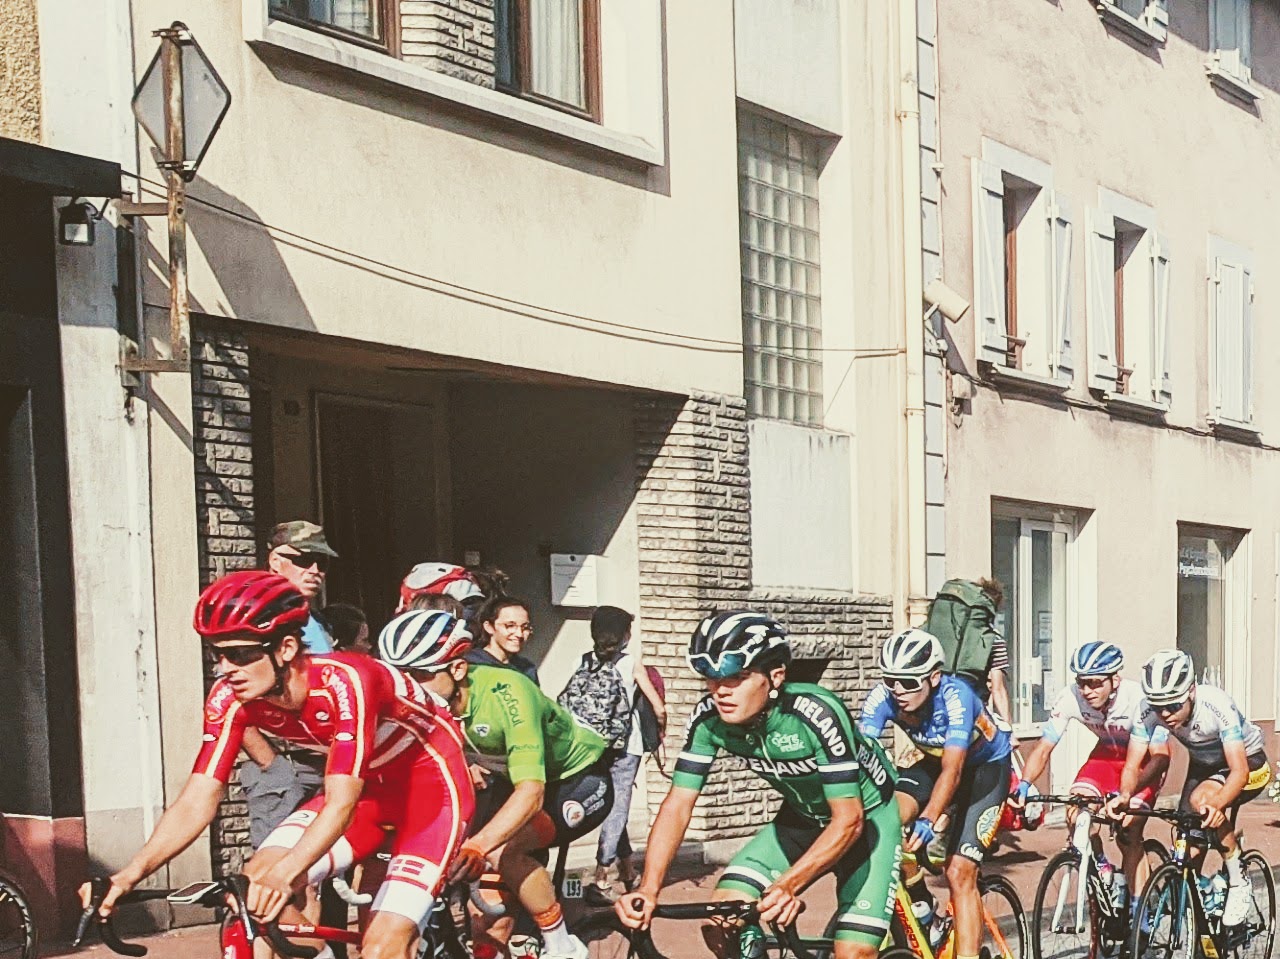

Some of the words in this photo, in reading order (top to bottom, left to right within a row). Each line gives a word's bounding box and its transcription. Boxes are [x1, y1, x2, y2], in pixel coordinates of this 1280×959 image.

[793, 695, 847, 757] IRELAND
[566, 880, 582, 897] 193
[884, 844, 903, 915] IRELAND
